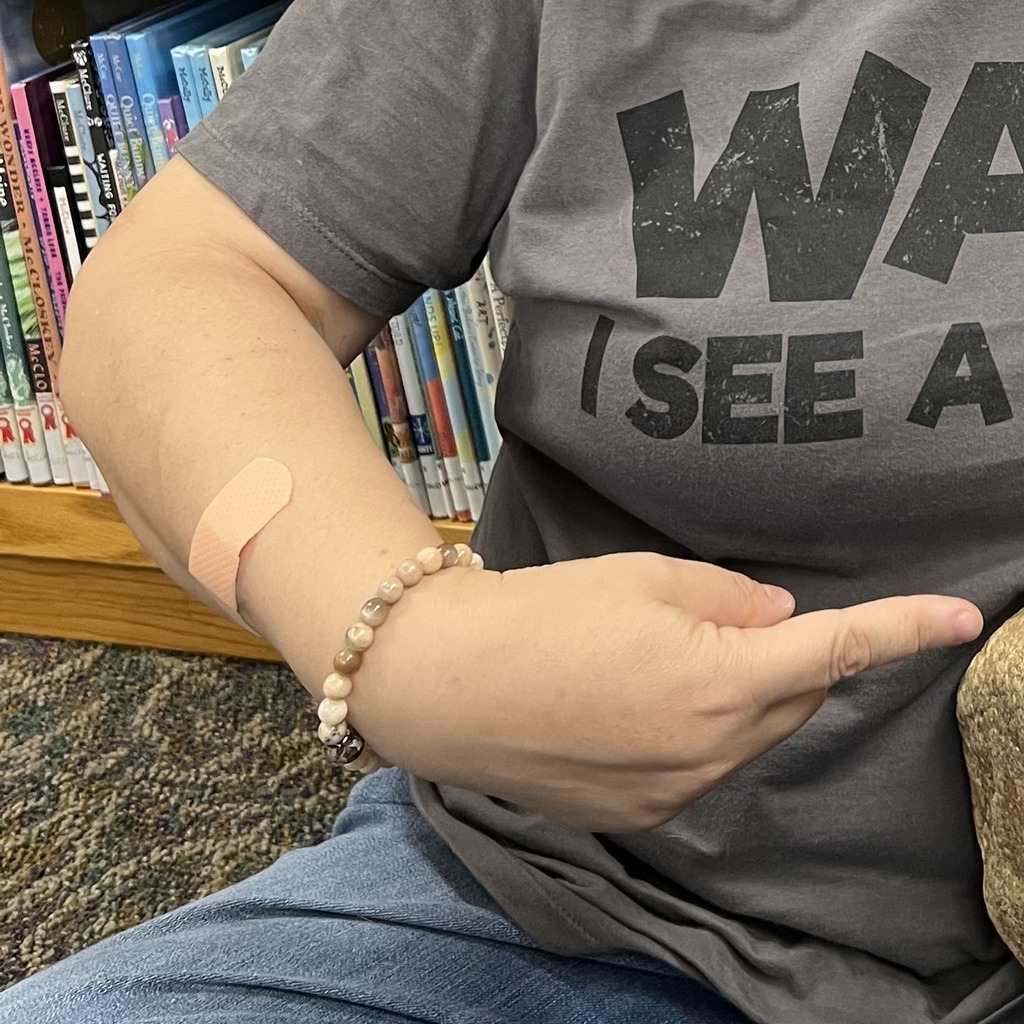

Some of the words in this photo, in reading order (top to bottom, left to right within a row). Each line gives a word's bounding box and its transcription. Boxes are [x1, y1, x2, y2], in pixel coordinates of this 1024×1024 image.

[98, 153, 113, 199] WAITING
[581, 317, 614, 416] I
[627, 331, 863, 445] SEE
[907, 322, 1013, 428] A
